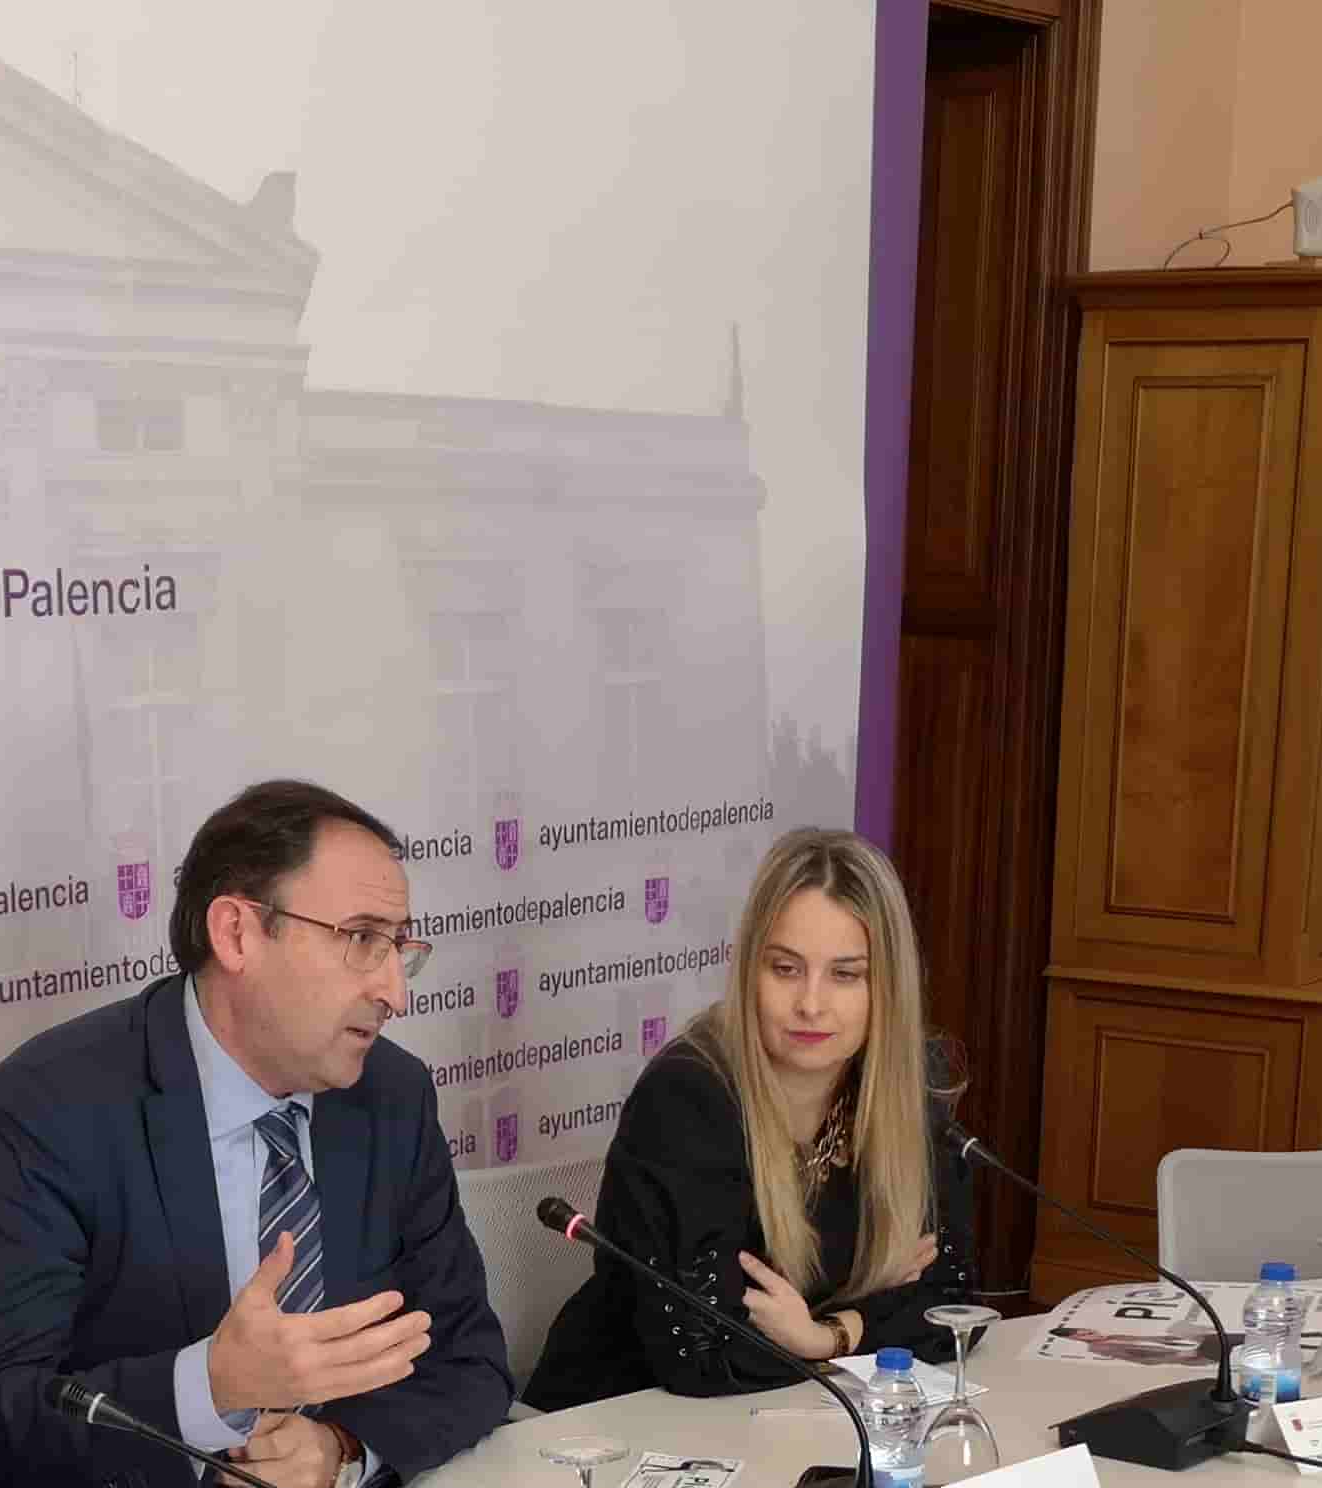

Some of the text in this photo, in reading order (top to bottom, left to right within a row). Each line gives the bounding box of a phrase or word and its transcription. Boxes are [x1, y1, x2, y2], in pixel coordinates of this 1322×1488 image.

[4, 564, 178, 619] Palencia
[538, 797, 775, 848] ayuntamientodepalencia
[408, 886, 626, 938] ntamientodepalencia
[538, 940, 732, 996] ayuntamientodepale
[428, 1027, 623, 1088] tamientodepalencia
